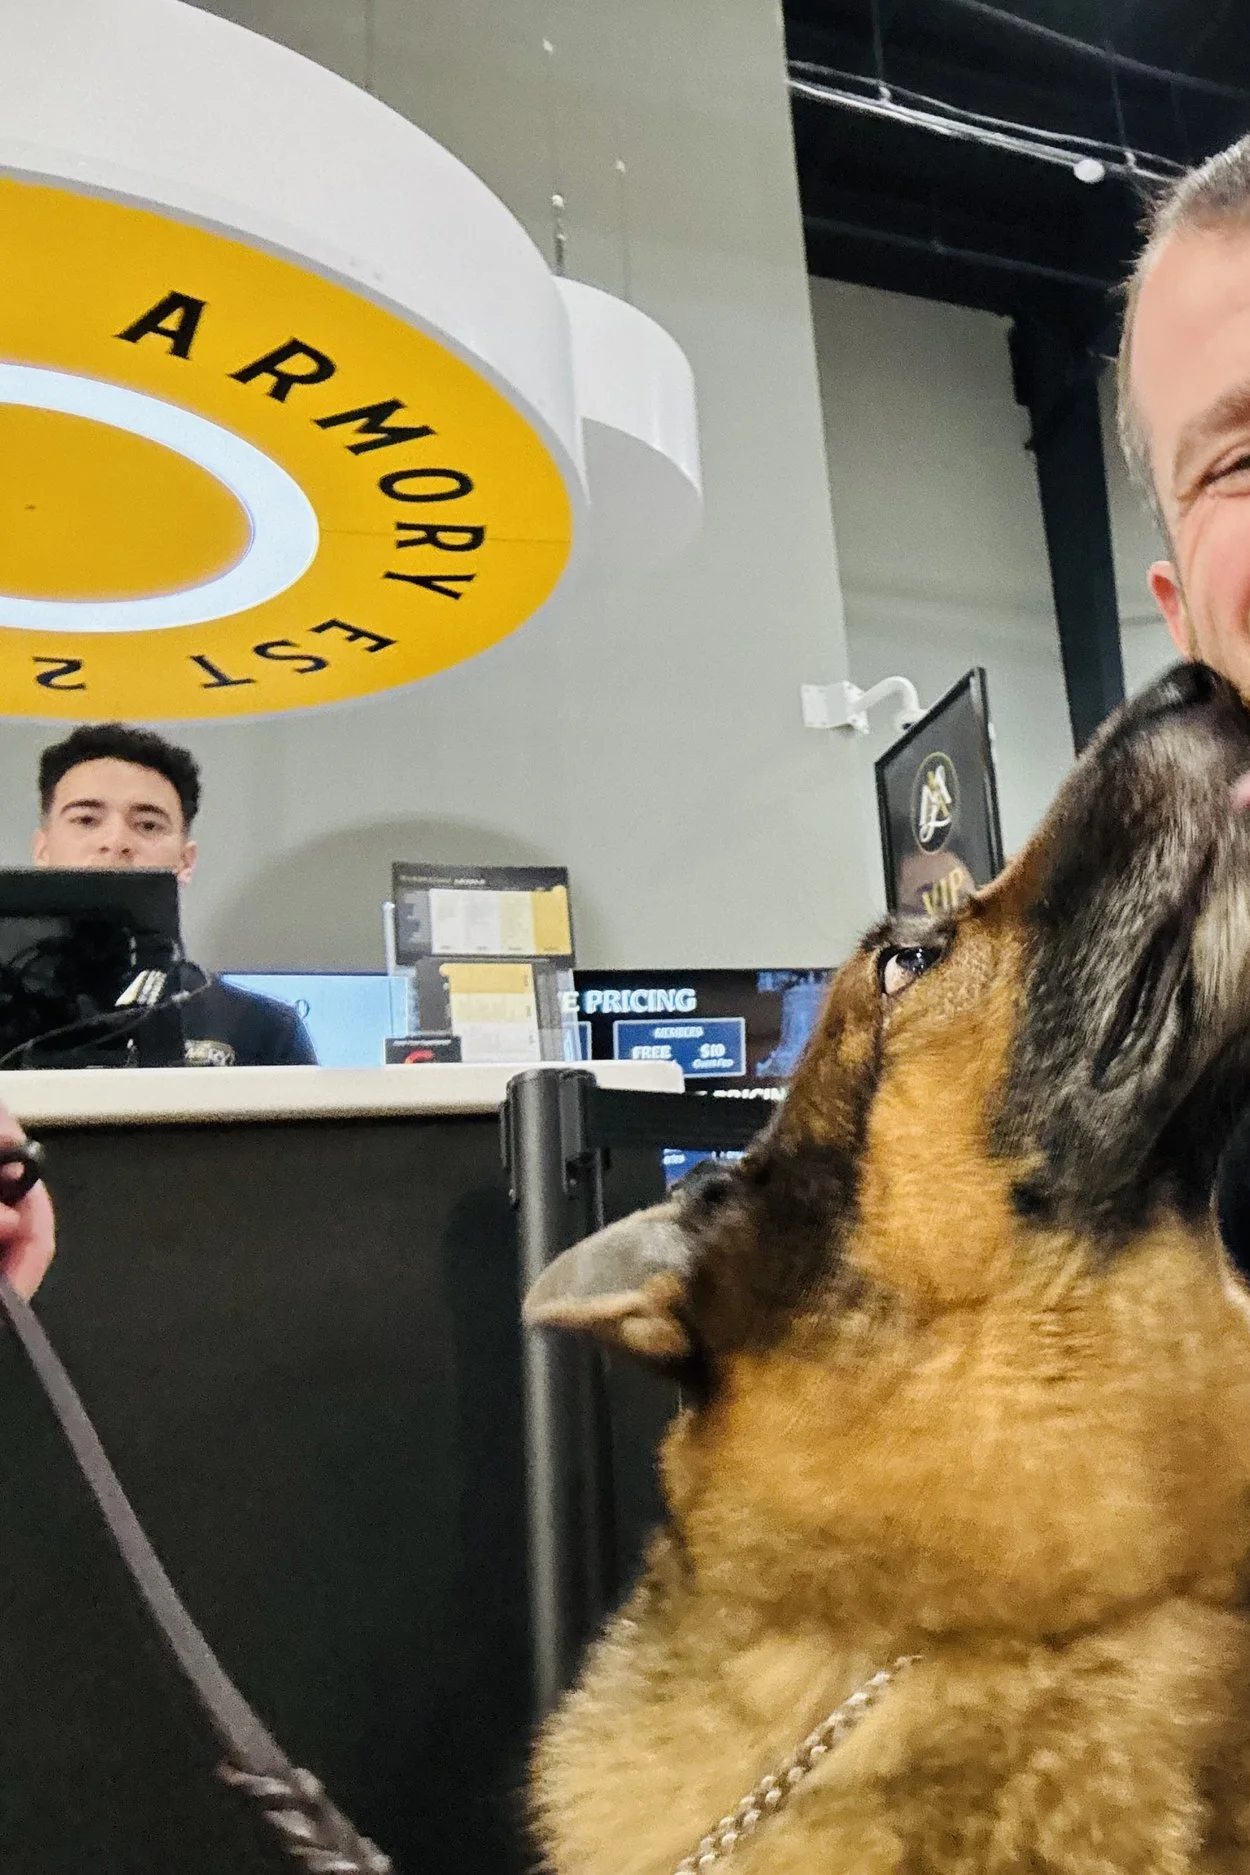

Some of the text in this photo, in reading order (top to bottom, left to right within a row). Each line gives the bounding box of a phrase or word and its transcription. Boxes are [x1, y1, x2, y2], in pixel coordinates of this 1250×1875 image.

[113, 290, 486, 600] ARMORY
[189, 617, 396, 690] EST
[922, 867, 964, 915] VIP
[584, 988, 697, 1014] PRICING
[631, 1043, 726, 1059] FREE $10
